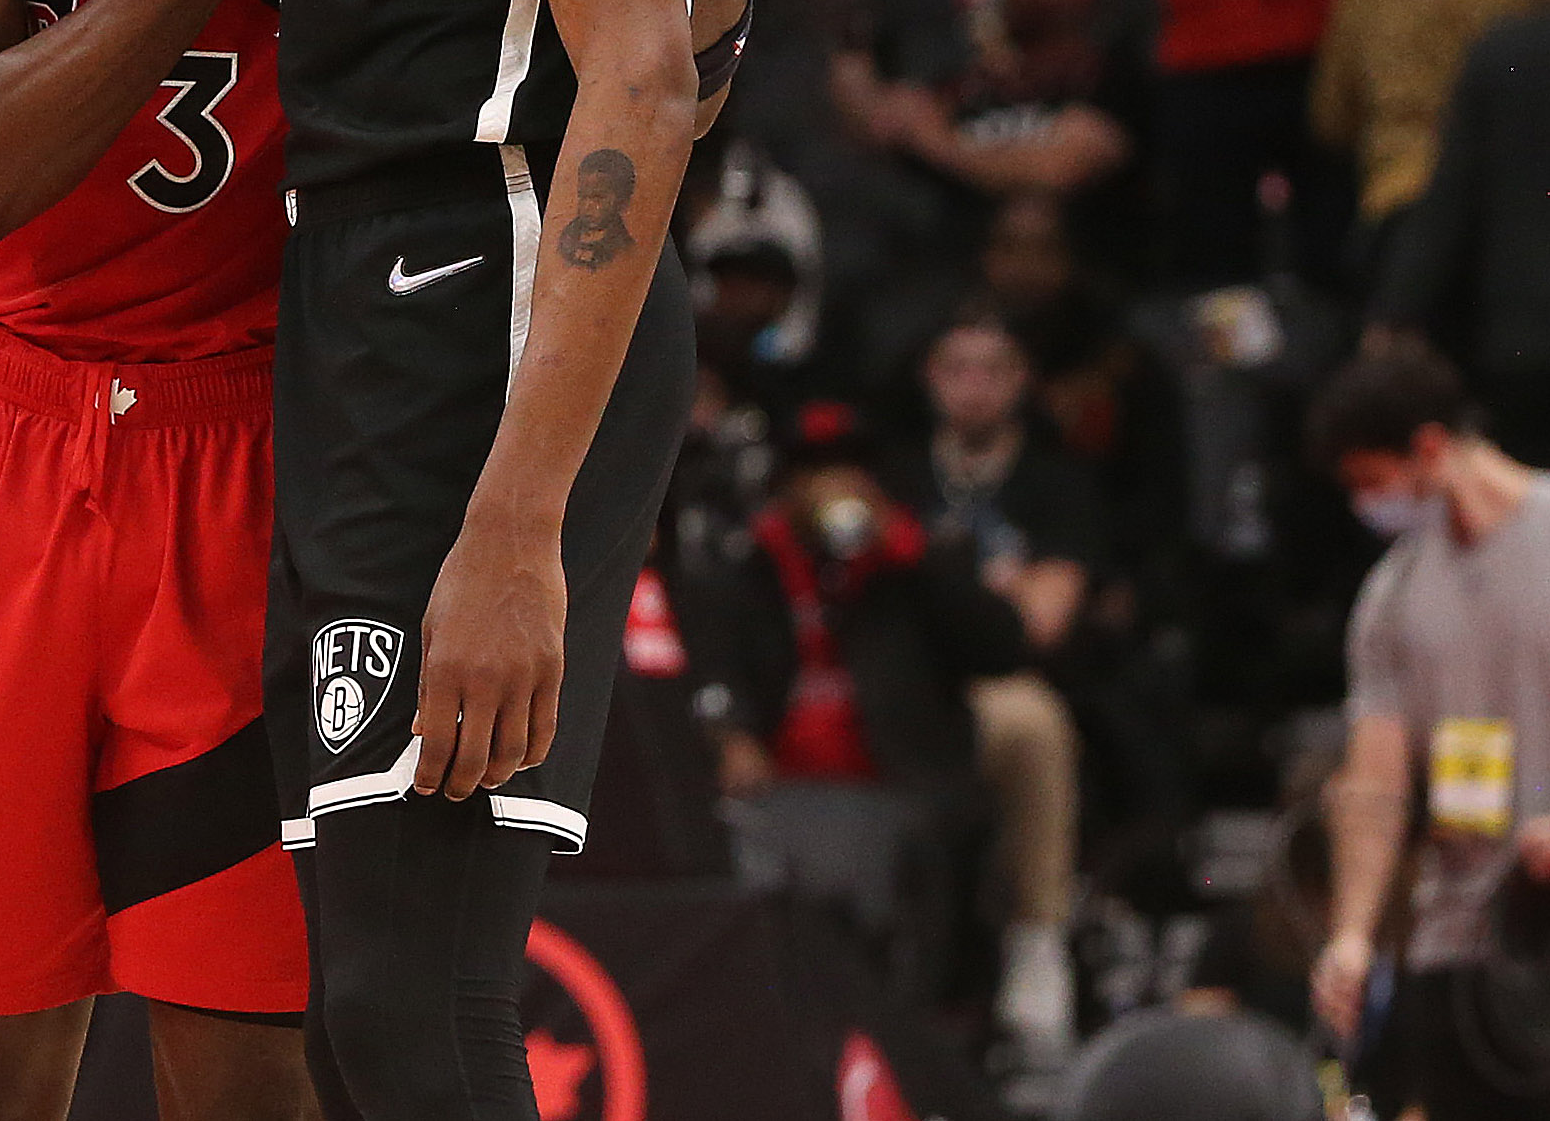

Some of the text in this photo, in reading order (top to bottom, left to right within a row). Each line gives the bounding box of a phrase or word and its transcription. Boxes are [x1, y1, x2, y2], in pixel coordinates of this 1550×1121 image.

[127, 50, 238, 214] 3
[314, 626, 393, 687] NETS
[333, 687, 347, 731] B
